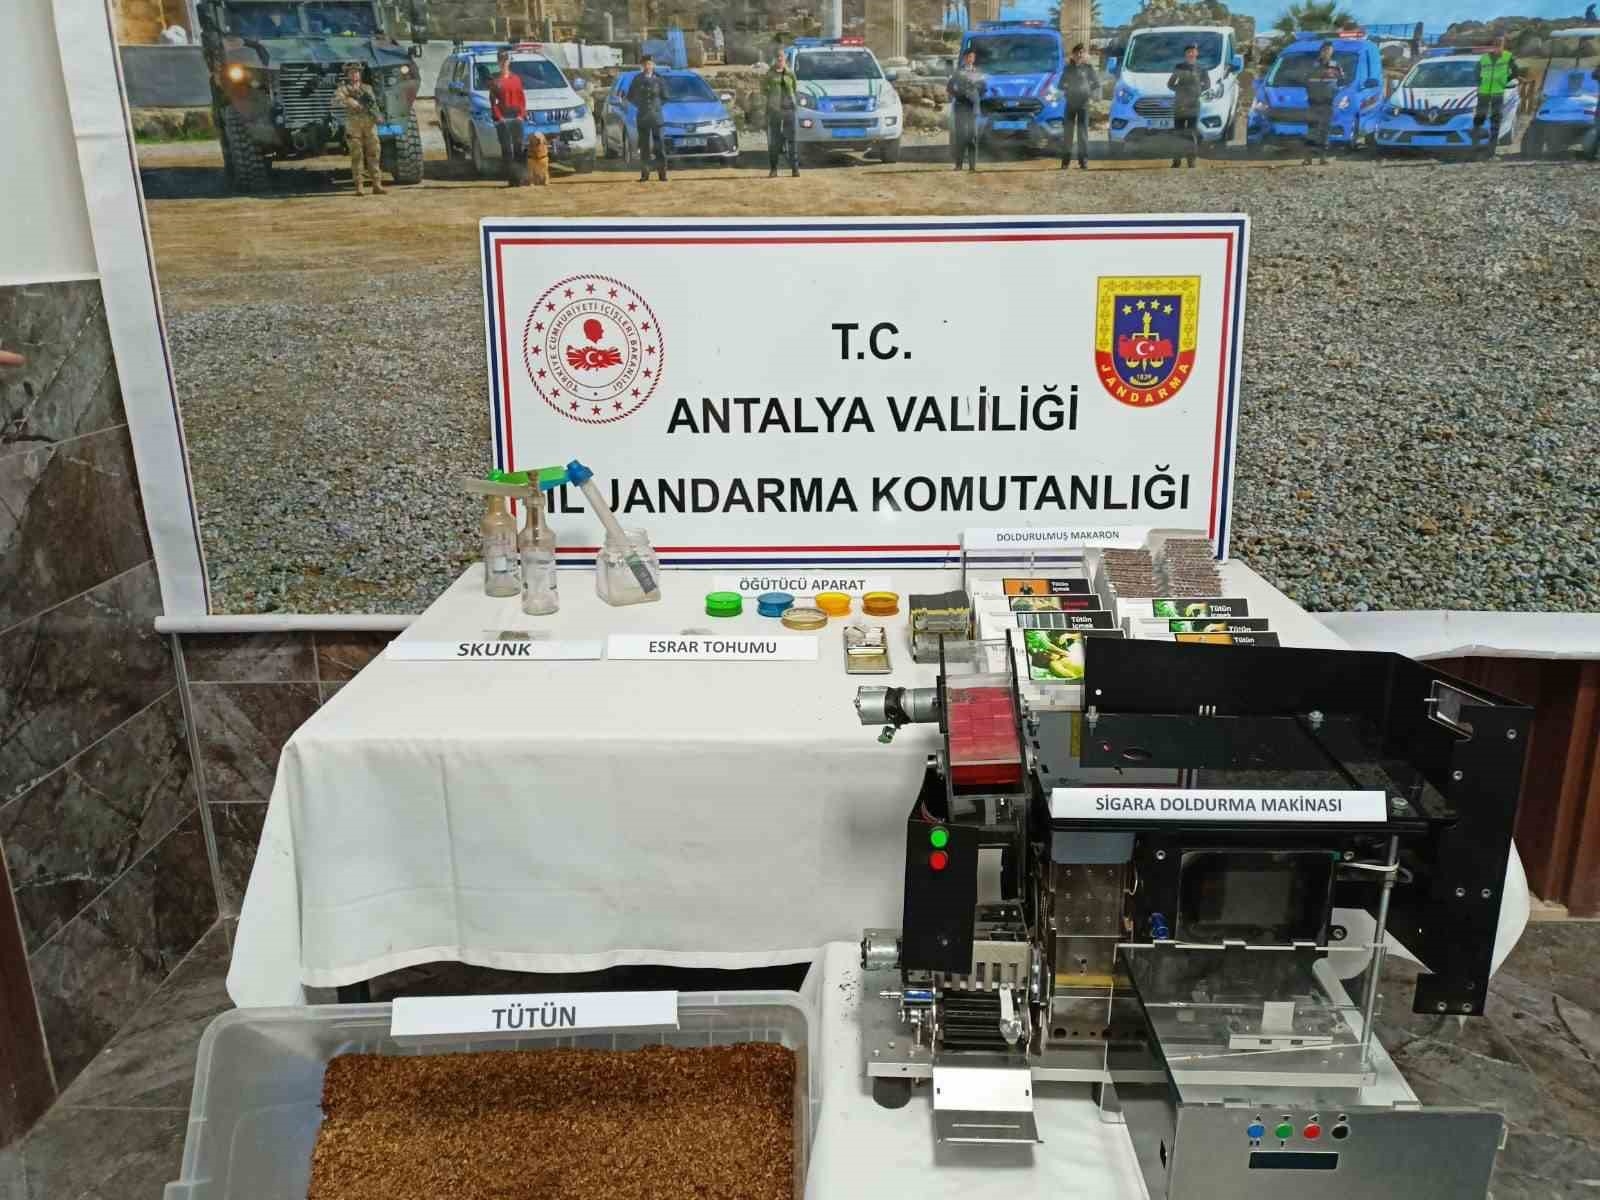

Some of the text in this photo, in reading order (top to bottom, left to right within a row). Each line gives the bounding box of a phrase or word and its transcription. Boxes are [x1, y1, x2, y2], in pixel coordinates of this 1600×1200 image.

[832, 322, 912, 360] T.C.
[1101, 364, 1190, 403] JANDARMA
[667, 385, 1079, 434] ANTALYA VALİLİĞİ
[608, 477, 858, 514] JANDARMA
[873, 463, 1190, 512] KOMUTANLIĞI
[996, 531, 1120, 542] DOLDURULMUŞ MAKARON
[739, 577, 866, 591] ÖĞÜTÜCÜ APARAT
[457, 641, 532, 656] SKUNK
[648, 640, 777, 654] ESRAR TOHUMU
[1095, 793, 1342, 812] SİGARA DOLDURMA MAKİNASI
[491, 1002, 576, 1029] TÜTÜN
